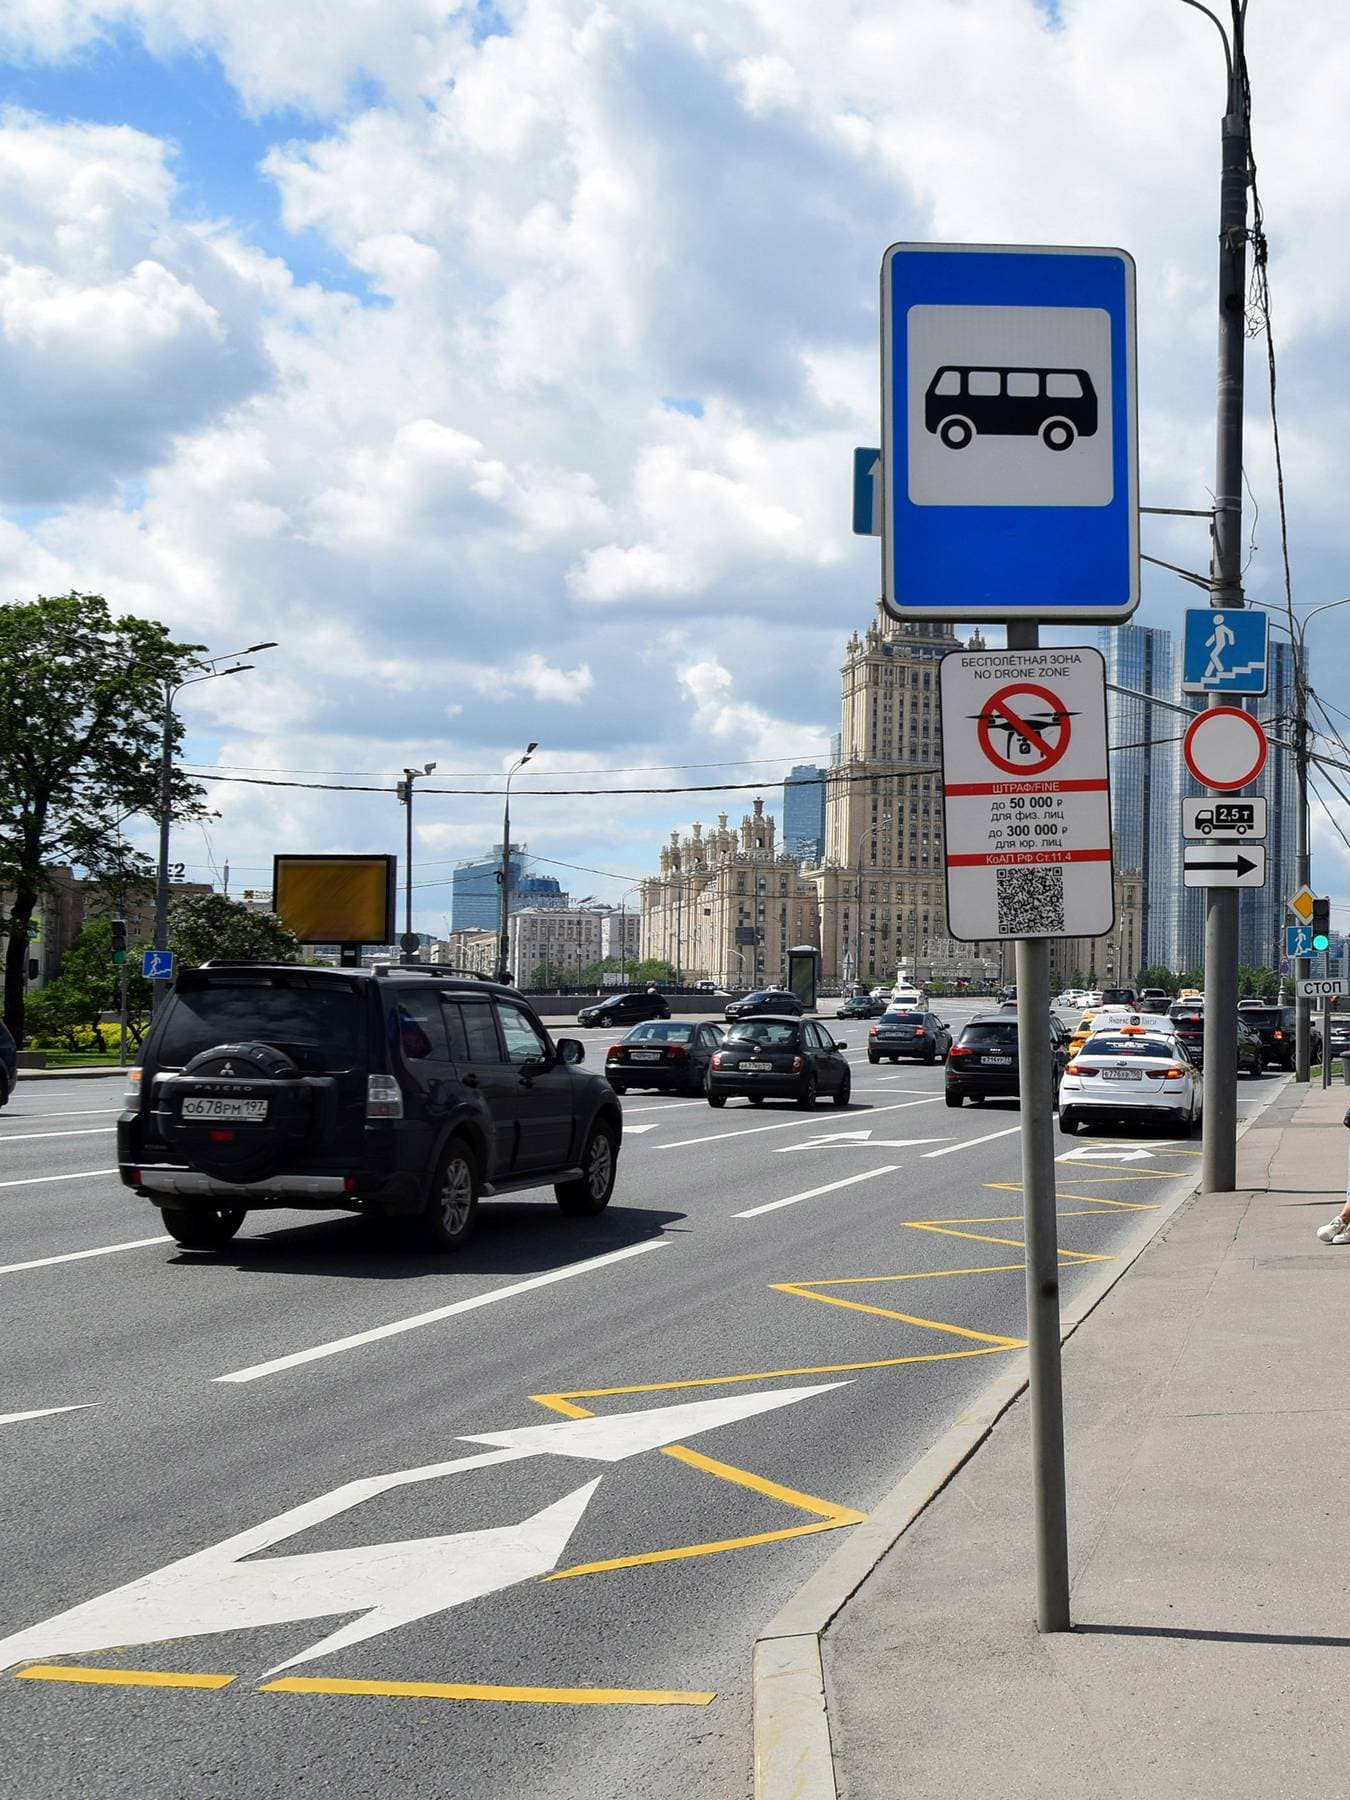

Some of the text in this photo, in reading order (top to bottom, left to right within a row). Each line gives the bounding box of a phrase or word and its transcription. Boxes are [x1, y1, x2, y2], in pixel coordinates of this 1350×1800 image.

[961, 654, 1082, 668] БЕСПОЛЁТНАЯ ЗОНА
[974, 667, 1070, 680] NO DRONE ZONE
[992, 783, 1060, 794] ШТРАФ/FINE
[991, 801, 1006, 812] до
[1009, 797, 1025, 809] 50
[1029, 796, 1053, 809] 000
[991, 810, 1064, 823] для физ. лиц
[1219, 808, 1240, 821] 2,5
[988, 829, 1003, 839] до
[1006, 825, 1030, 837] 300
[1034, 824, 1058, 836] 000
[995, 838, 1062, 851] для юр. лиц
[986, 853, 1016, 865] КоАП
[1017, 852, 1034, 863] РФ
[1304, 981, 1342, 995] СТОП
[194, 1084, 253, 1092] PAJERO
